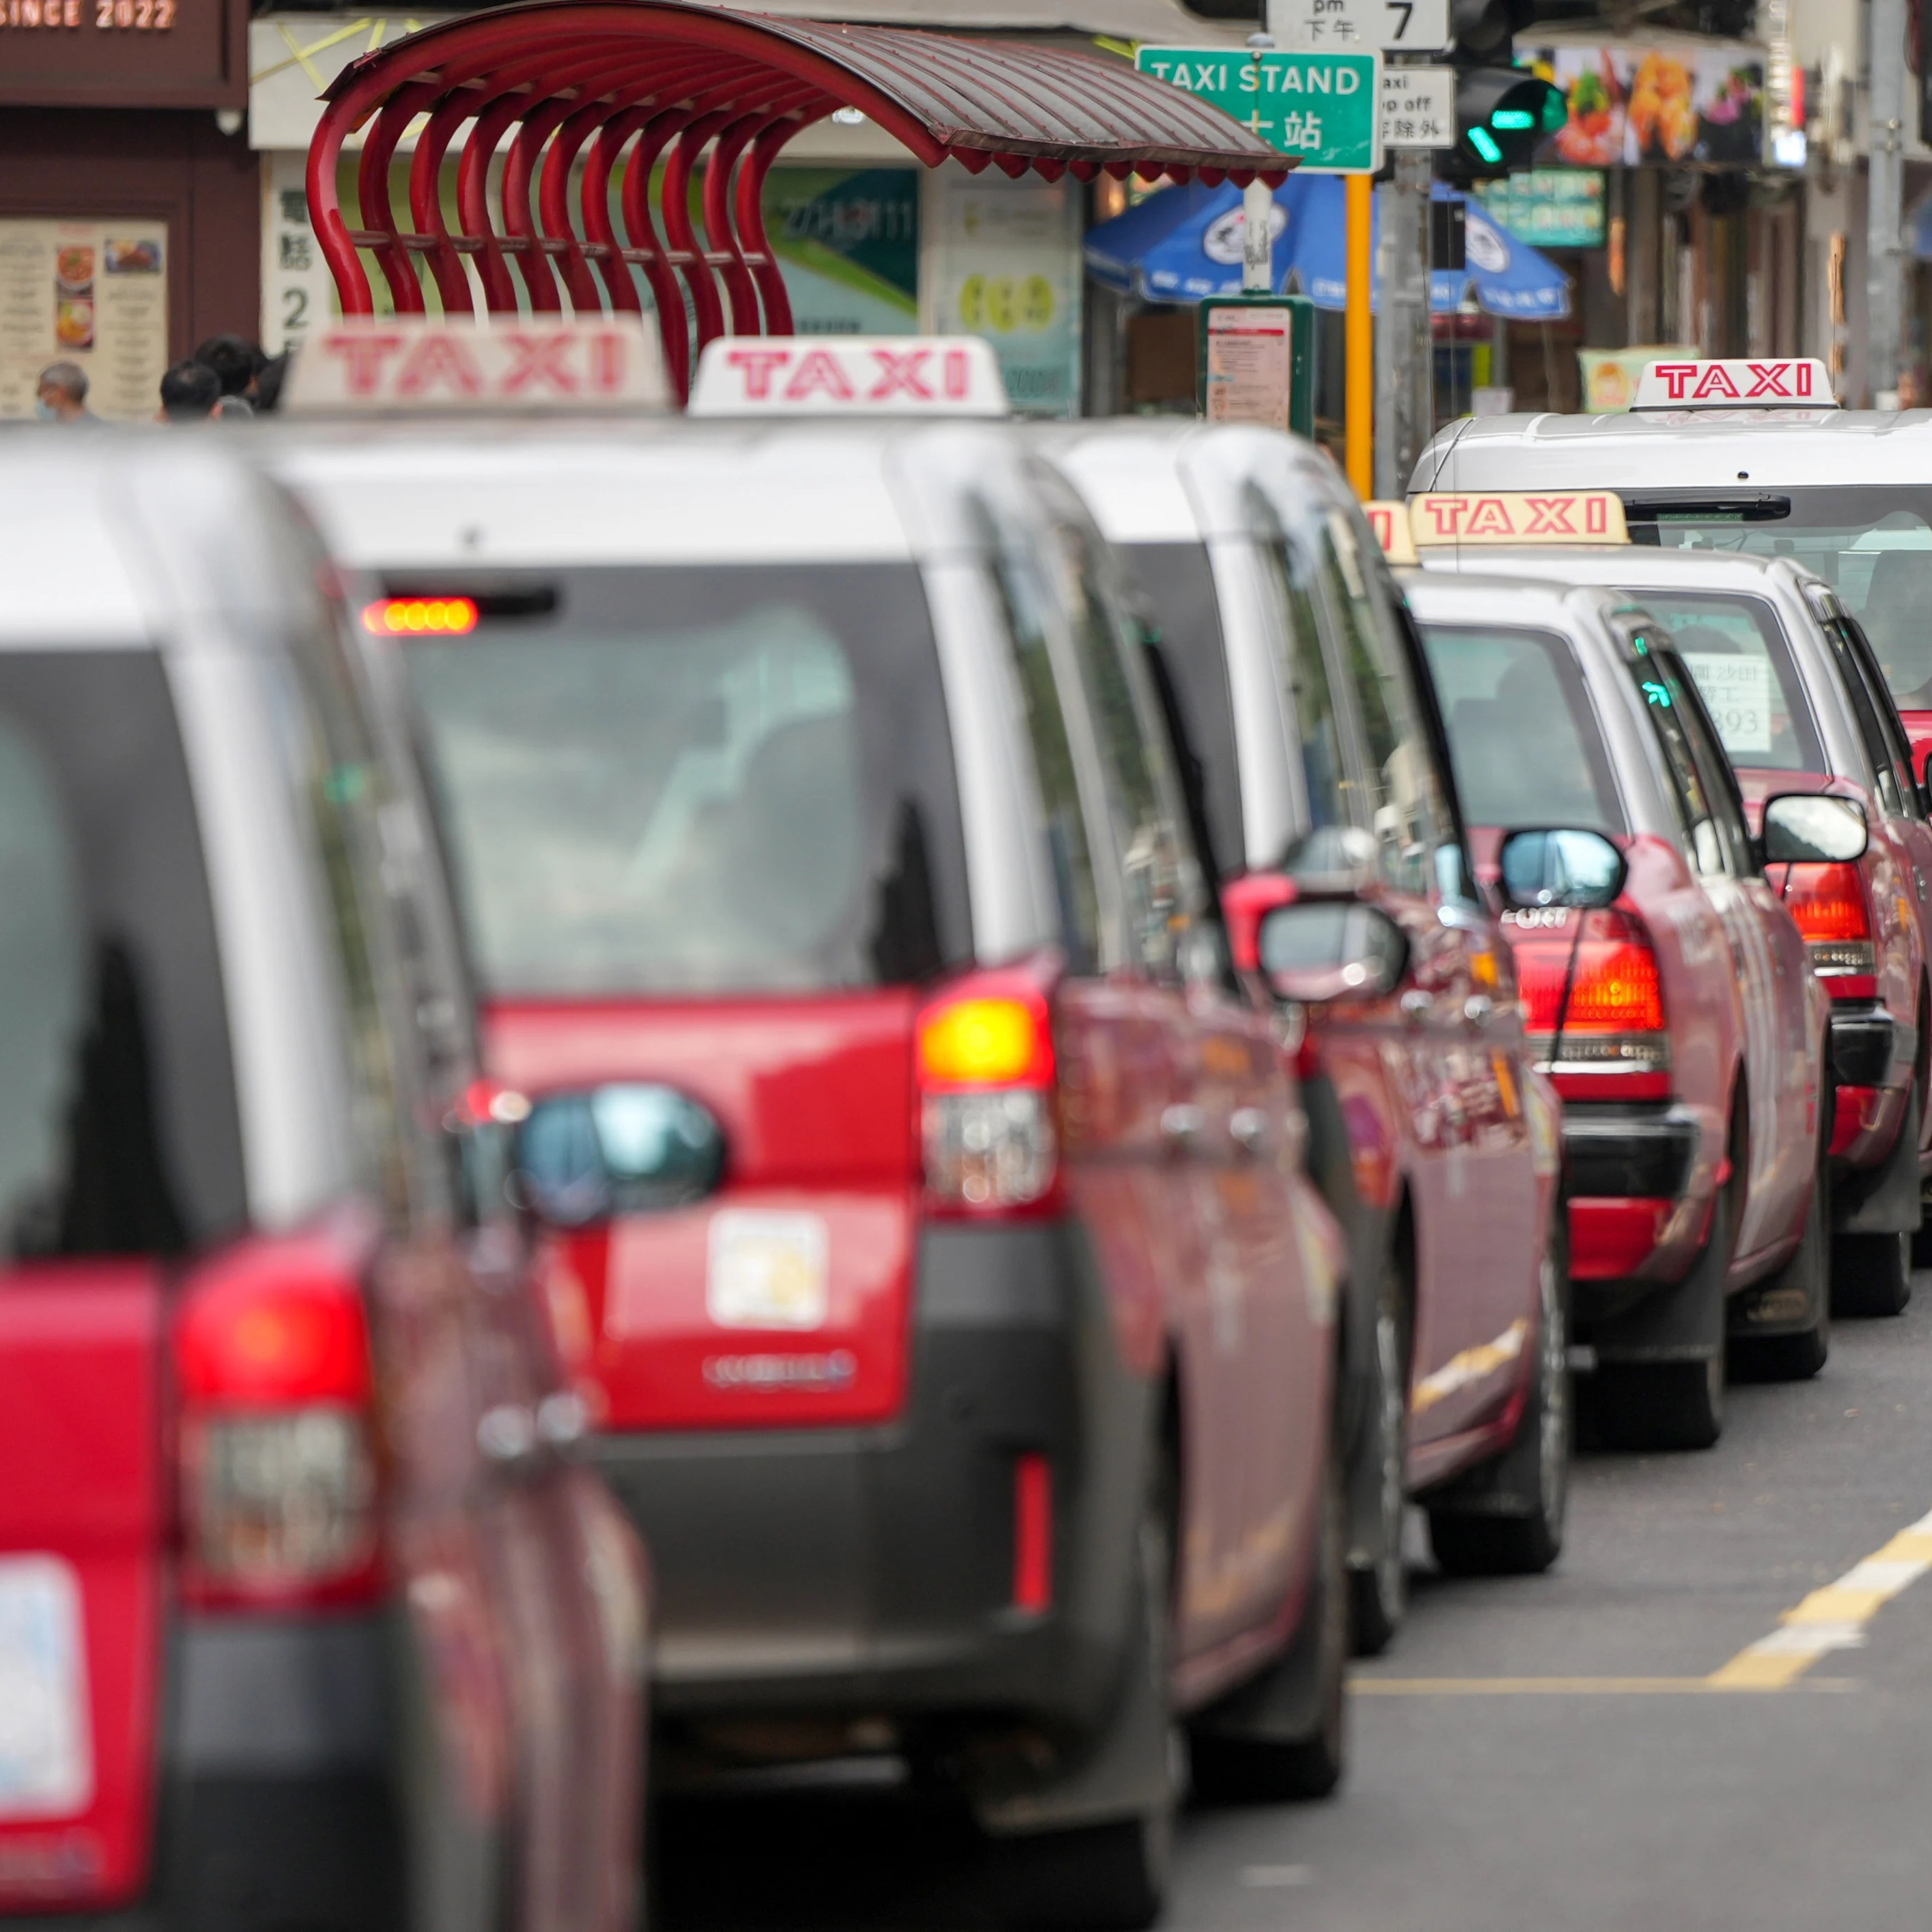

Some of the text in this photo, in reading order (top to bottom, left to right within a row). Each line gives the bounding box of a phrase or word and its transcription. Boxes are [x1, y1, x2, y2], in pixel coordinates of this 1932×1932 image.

[97, 0, 176, 28] 2022
[1313, 0, 1344, 13] pm
[1386, 2, 1413, 41] 7
[1305, 19, 1354, 41] 下午
[1151, 62, 1361, 95] TAXI STAND
[1383, 76, 1408, 90] axi
[1404, 96, 1432, 112] off
[324, 332, 628, 396] TAXI
[726, 348, 971, 401] TAXI
[1655, 363, 1812, 399] TAXI
[1425, 497, 1607, 535] TAXI
